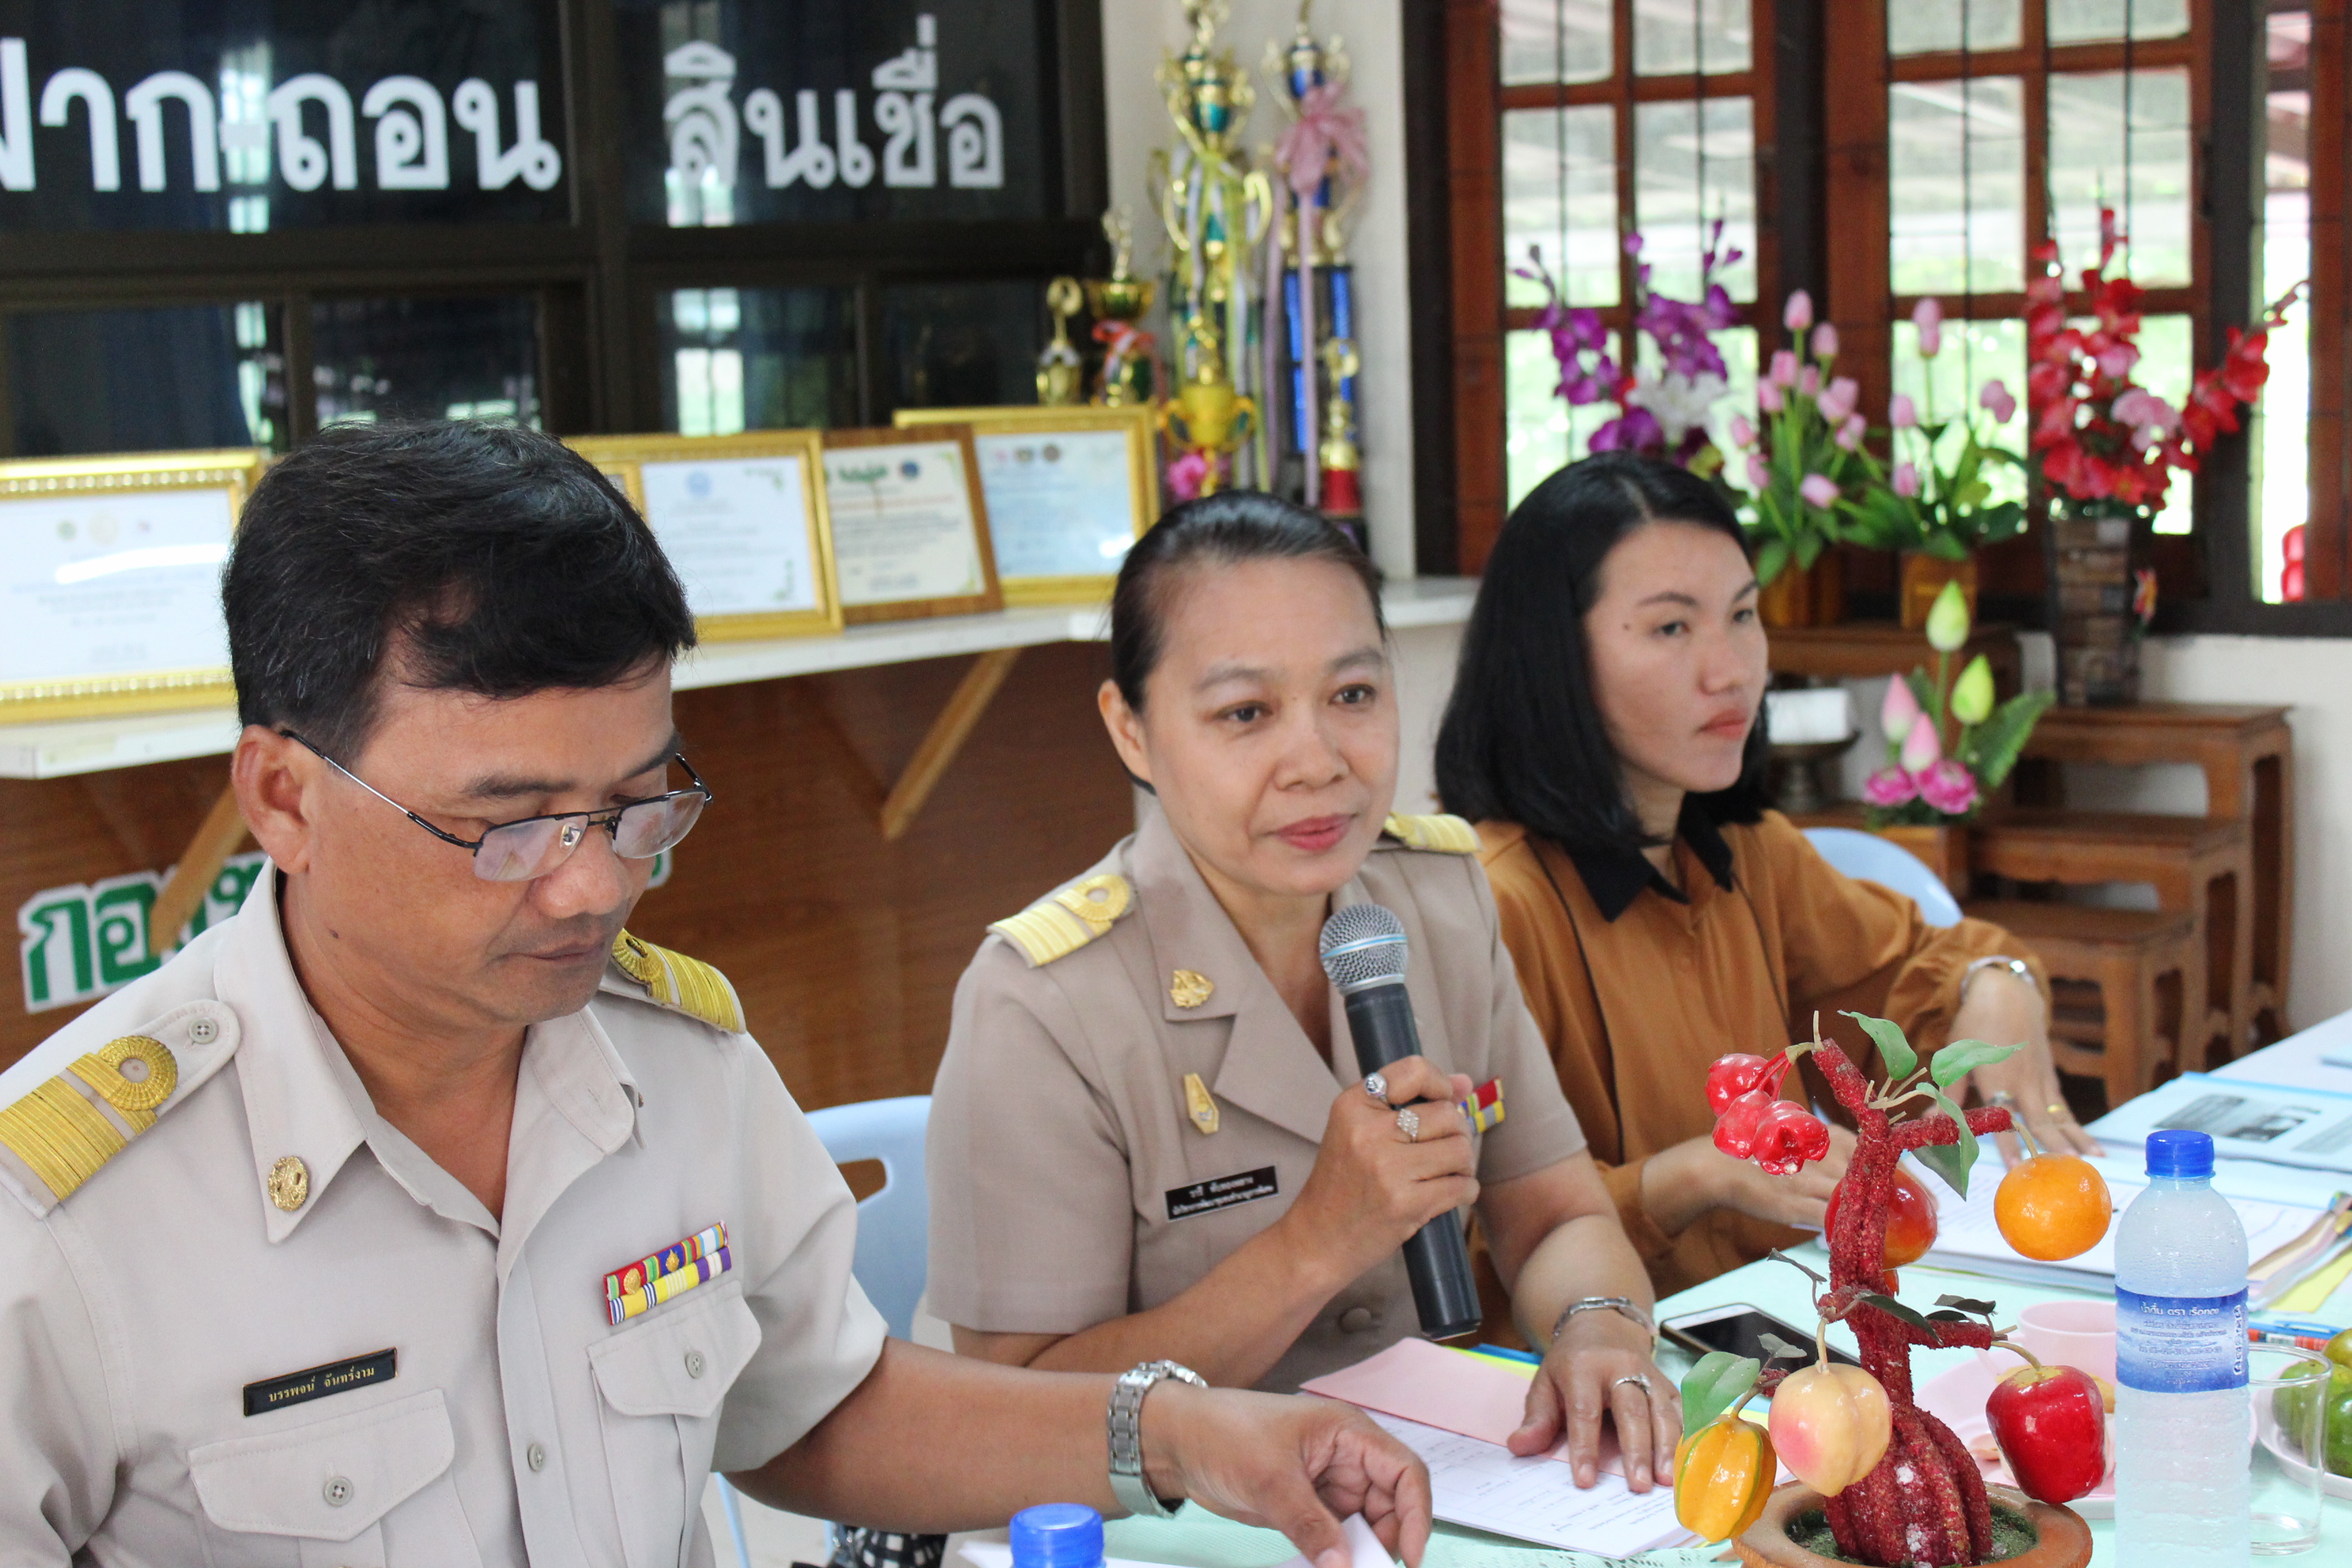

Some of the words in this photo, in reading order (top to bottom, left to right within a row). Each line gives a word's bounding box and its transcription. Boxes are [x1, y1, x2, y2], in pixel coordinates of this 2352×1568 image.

[663, 14, 1005, 189] สินเชื่อ
[323, 1366, 375, 1388] จันทร์งาม
